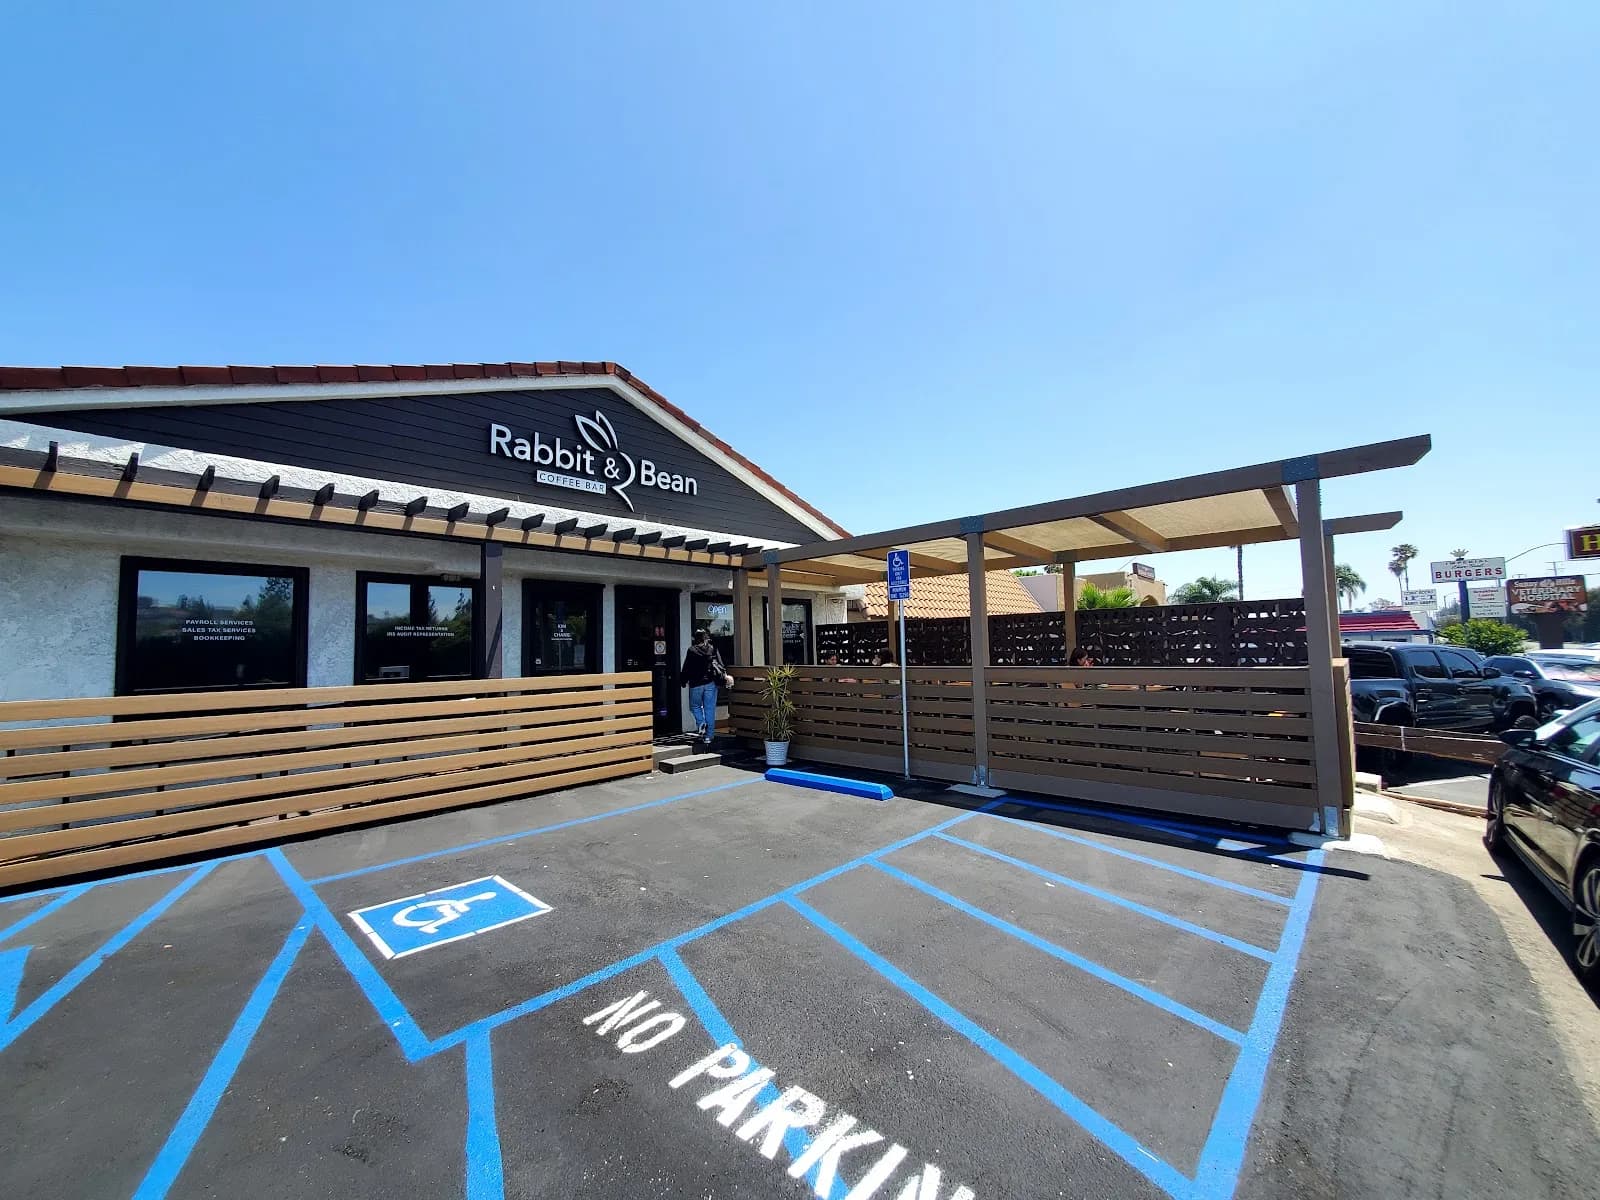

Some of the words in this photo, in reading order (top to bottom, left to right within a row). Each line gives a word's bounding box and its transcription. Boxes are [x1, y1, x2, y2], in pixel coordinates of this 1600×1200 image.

[490, 423, 595, 476] Rabbit
[603, 457, 621, 480] &
[640, 459, 698, 496] Bean
[539, 472, 582, 488] COFFEE
[585, 480, 606, 494] BAR
[1435, 567, 1503, 579] BURGERS
[1511, 585, 1582, 597] VETERINARY
[1519, 593, 1576, 602] HOSPITAL
[581, 989, 687, 1054] NO
